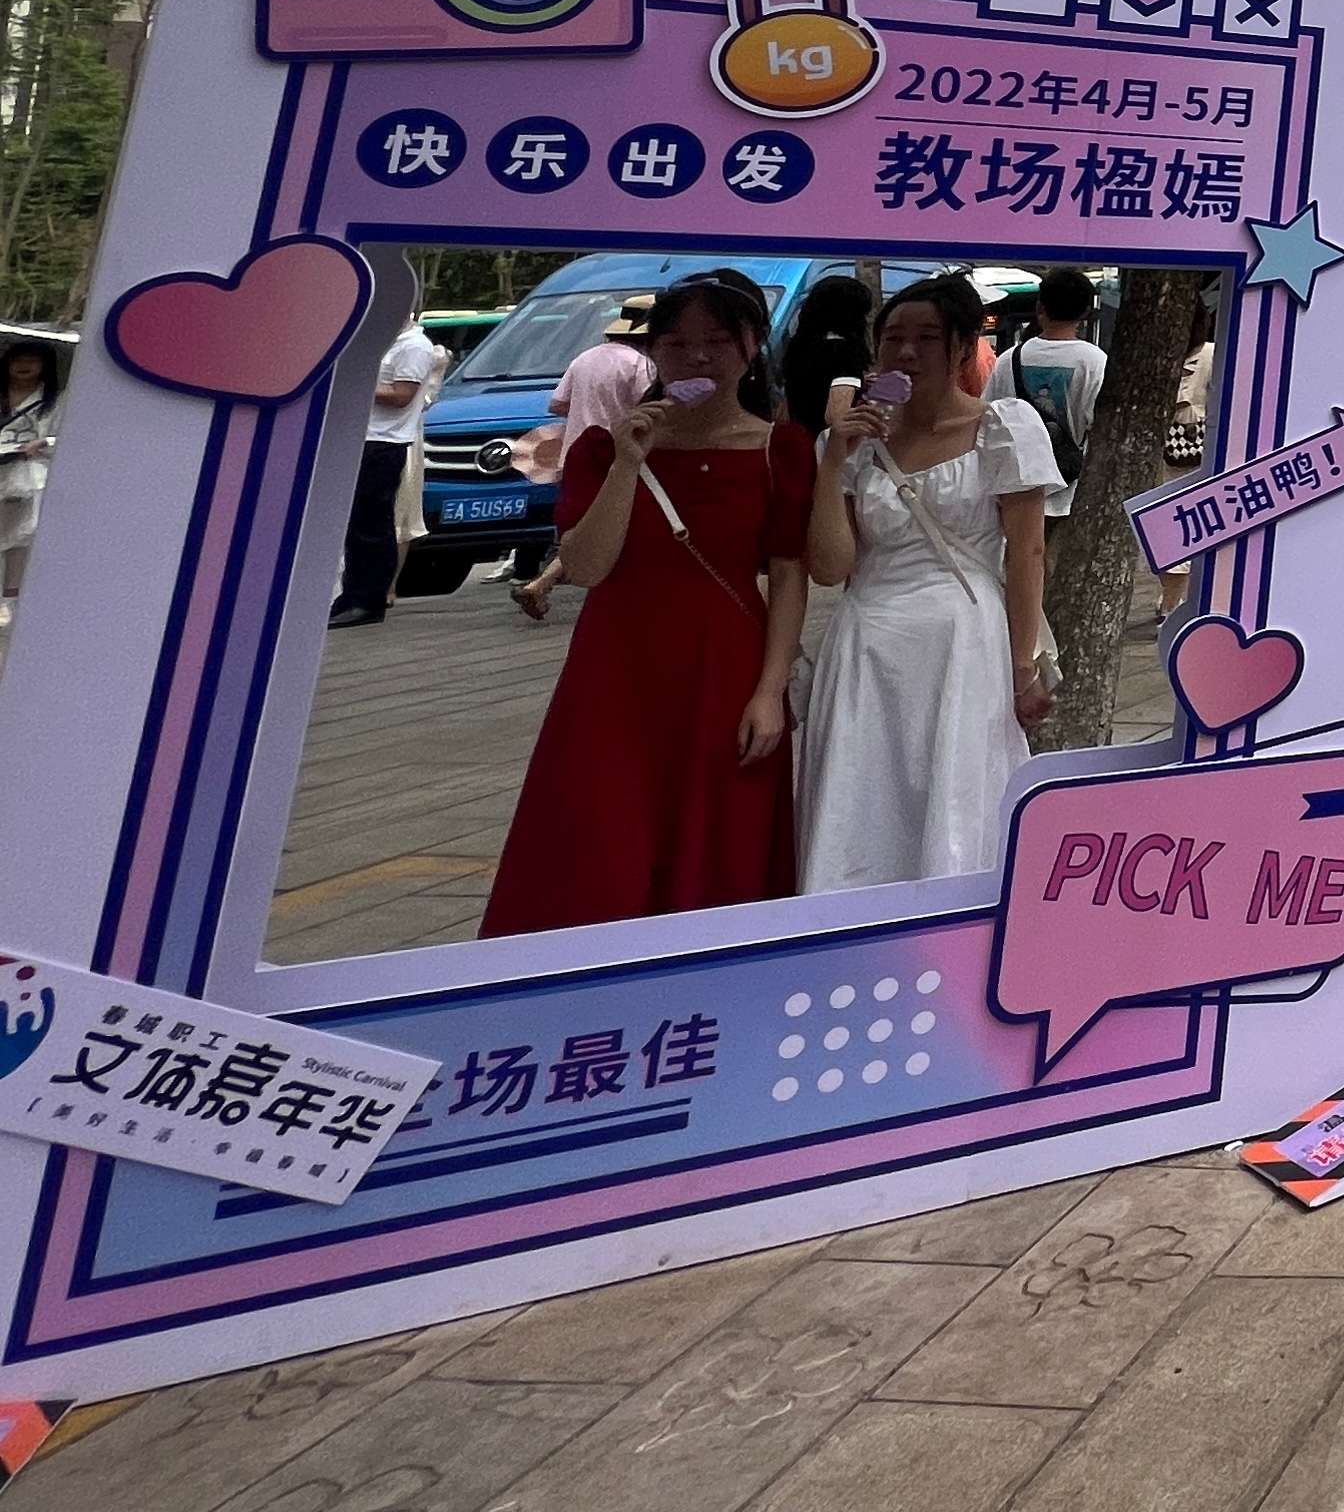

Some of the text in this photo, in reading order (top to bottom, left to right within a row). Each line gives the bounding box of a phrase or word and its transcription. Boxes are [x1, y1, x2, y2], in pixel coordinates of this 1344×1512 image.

[767, 41, 833, 80] kg
[895, 61, 1255, 129] 2022年4月-5月
[383, 121, 787, 193] 快乐出发
[874, 131, 1245, 223] 教场楹嫣
[1042, 832, 1227, 920] PICK
[50, 1030, 396, 1150] 文体嘉年华
[353, 1069, 409, 1092] Carnival
